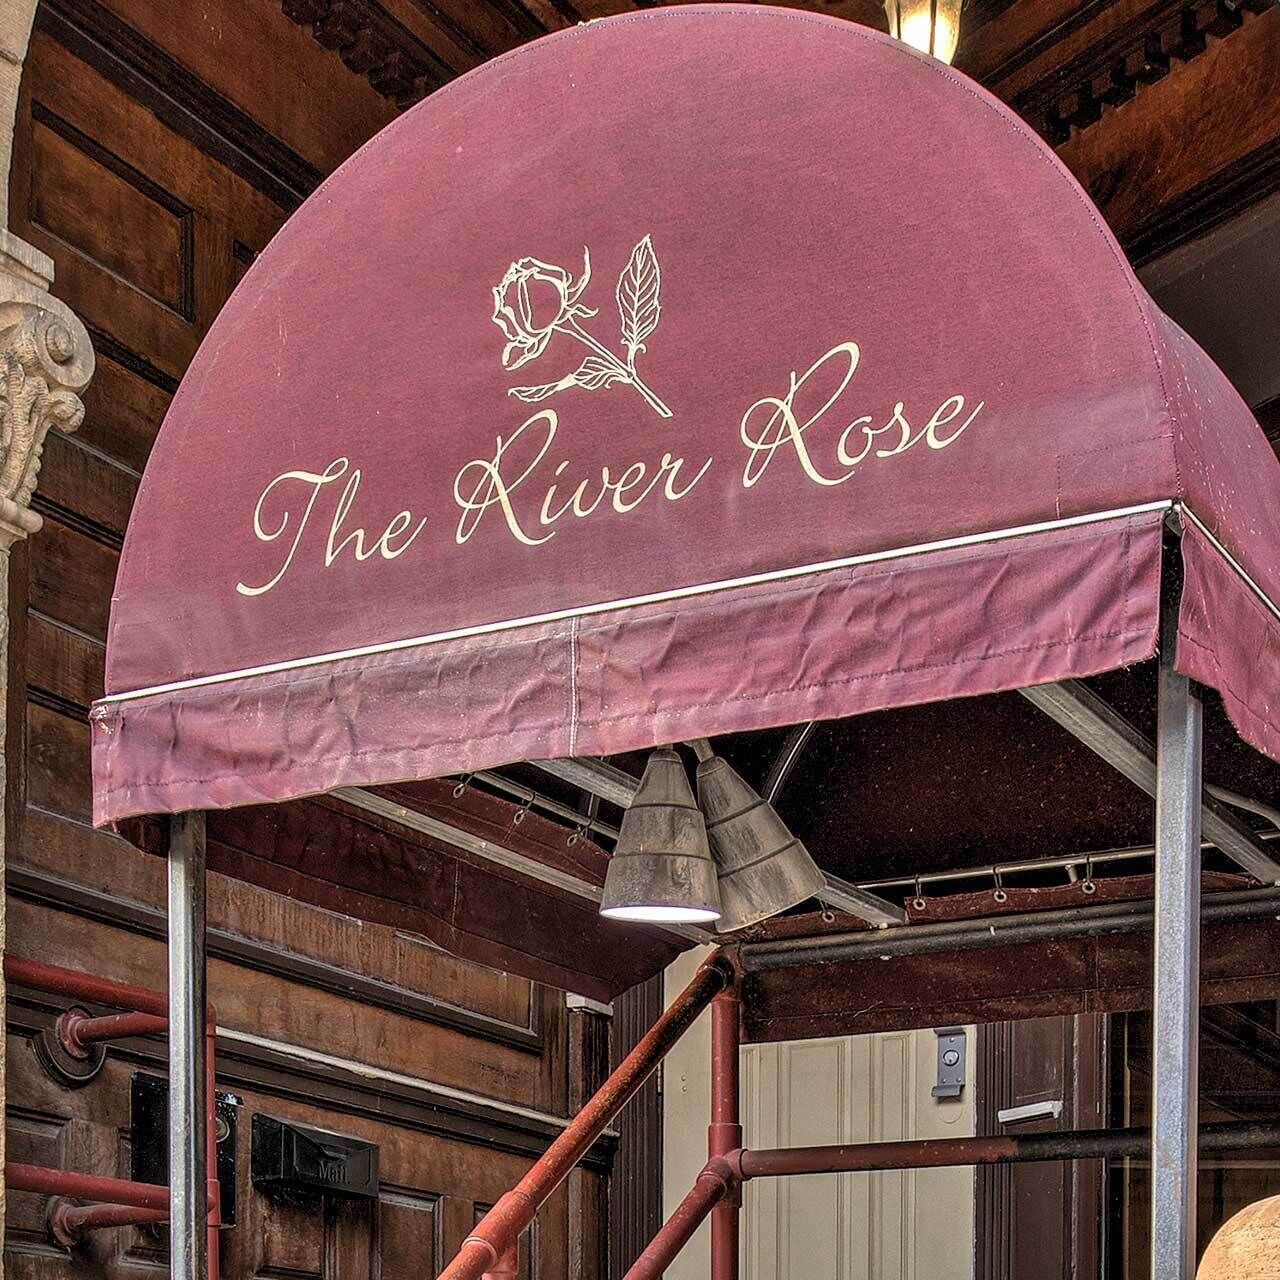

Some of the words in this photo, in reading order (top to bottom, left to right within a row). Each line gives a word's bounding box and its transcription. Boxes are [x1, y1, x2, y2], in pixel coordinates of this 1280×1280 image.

[235, 456, 427, 597] The
[453, 408, 713, 546] River
[740, 341, 985, 488] Rose
